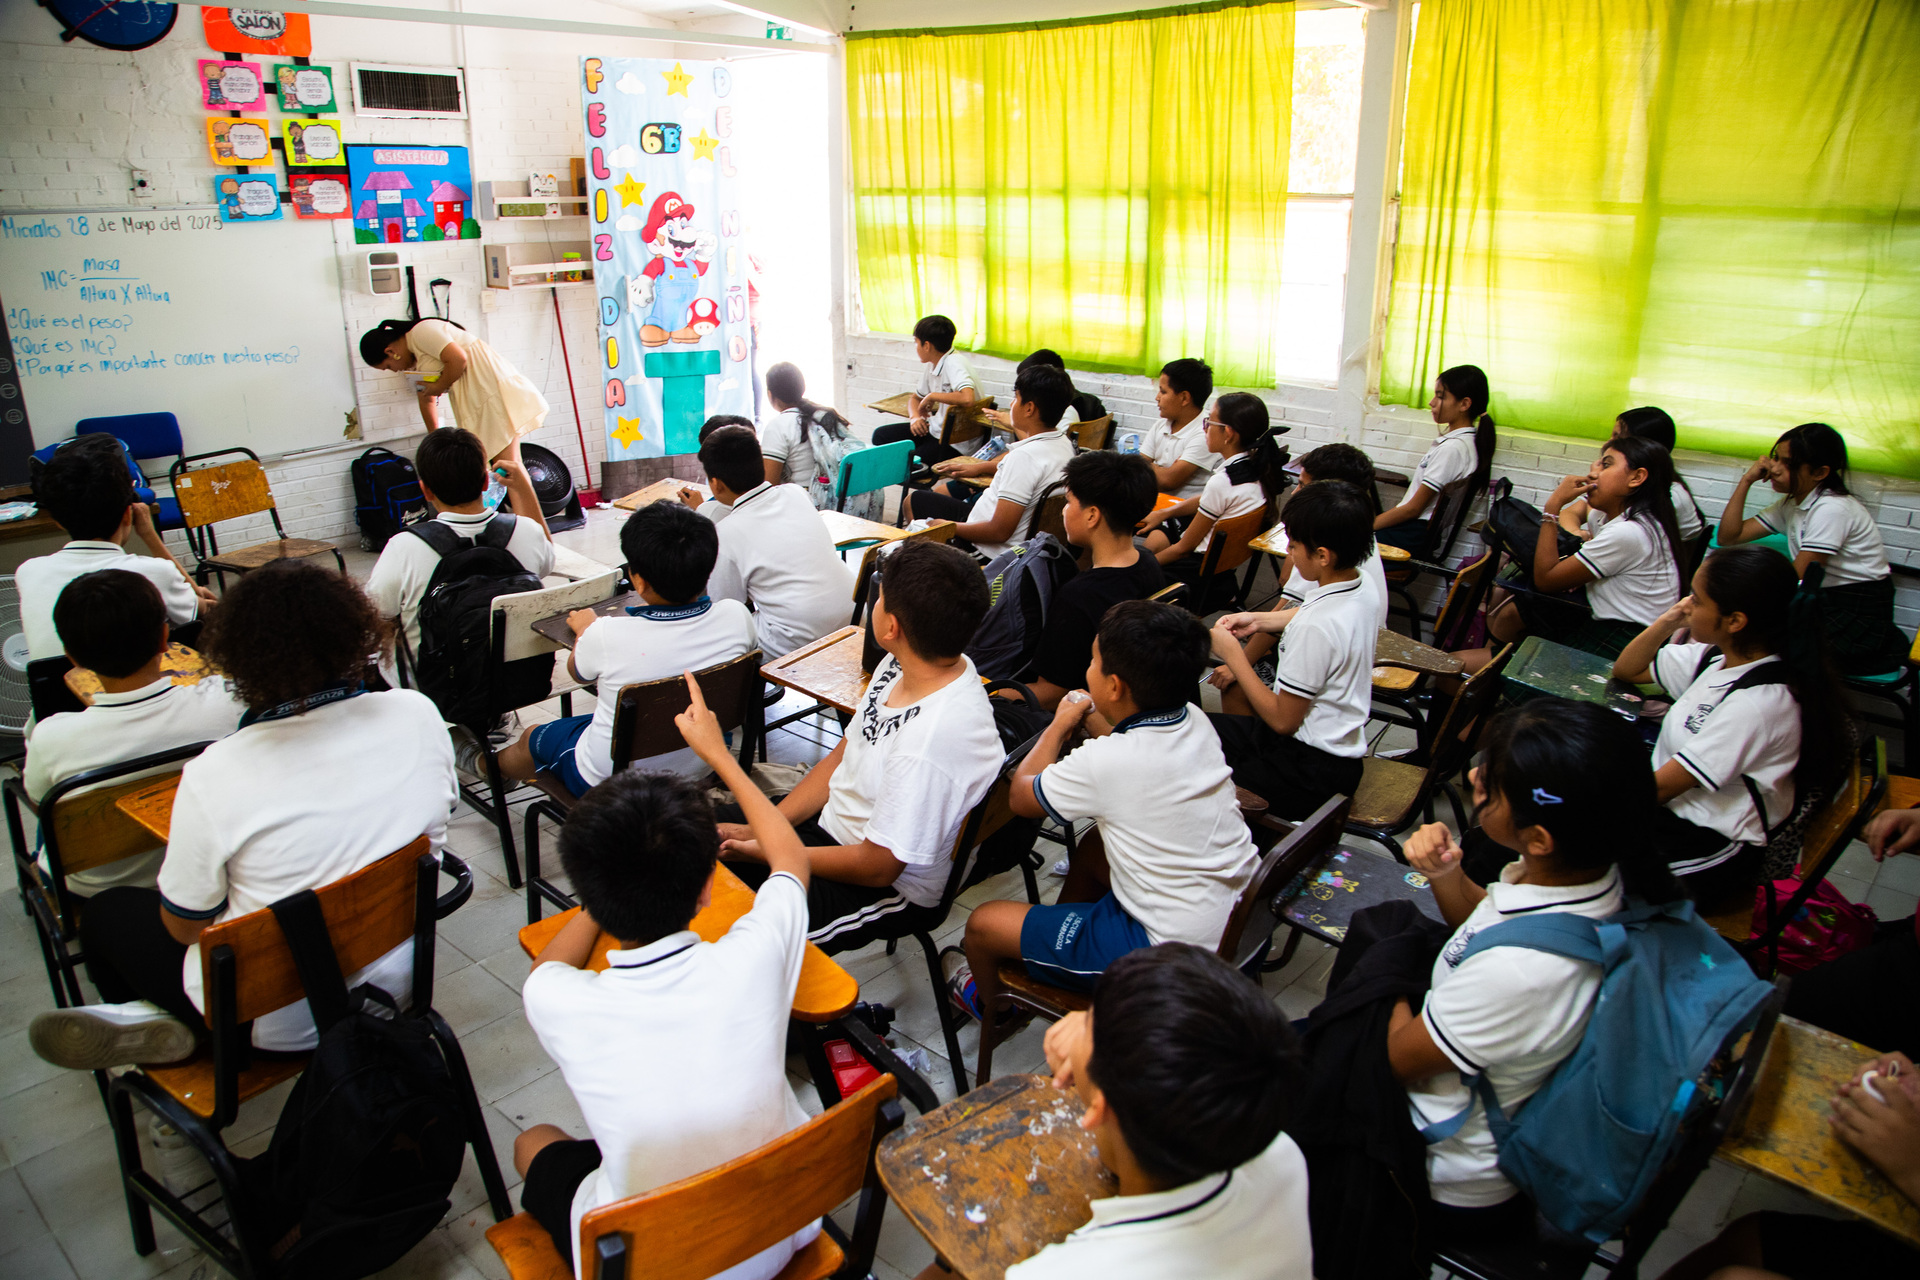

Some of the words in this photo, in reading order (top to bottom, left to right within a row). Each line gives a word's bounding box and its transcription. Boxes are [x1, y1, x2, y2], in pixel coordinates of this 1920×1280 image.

[237, 15, 281, 30] SALÓN
[712, 66, 738, 178] DEL
[641, 124, 682, 154] 6B
[376, 151, 447, 163] ASISTENCIA
[585, 58, 614, 262] FELIZ
[66, 215, 90, 236] 28
[97, 217, 117, 232] de
[122, 216, 156, 235] Mayo
[160, 215, 181, 231] del
[187, 215, 224, 231] 2025
[83, 258, 120, 273] Masa
[80, 284, 117, 304] Altura
[135, 283, 171, 304] Altura
[721, 210, 748, 362] NIÑO
[89, 314, 133, 334] peso?
[54, 340, 74, 353] es
[78, 361, 94, 373] es
[99, 351, 167, 375] importante
[264, 345, 301, 366] peso?
[276, 689, 344, 715] ZAAGOZA
